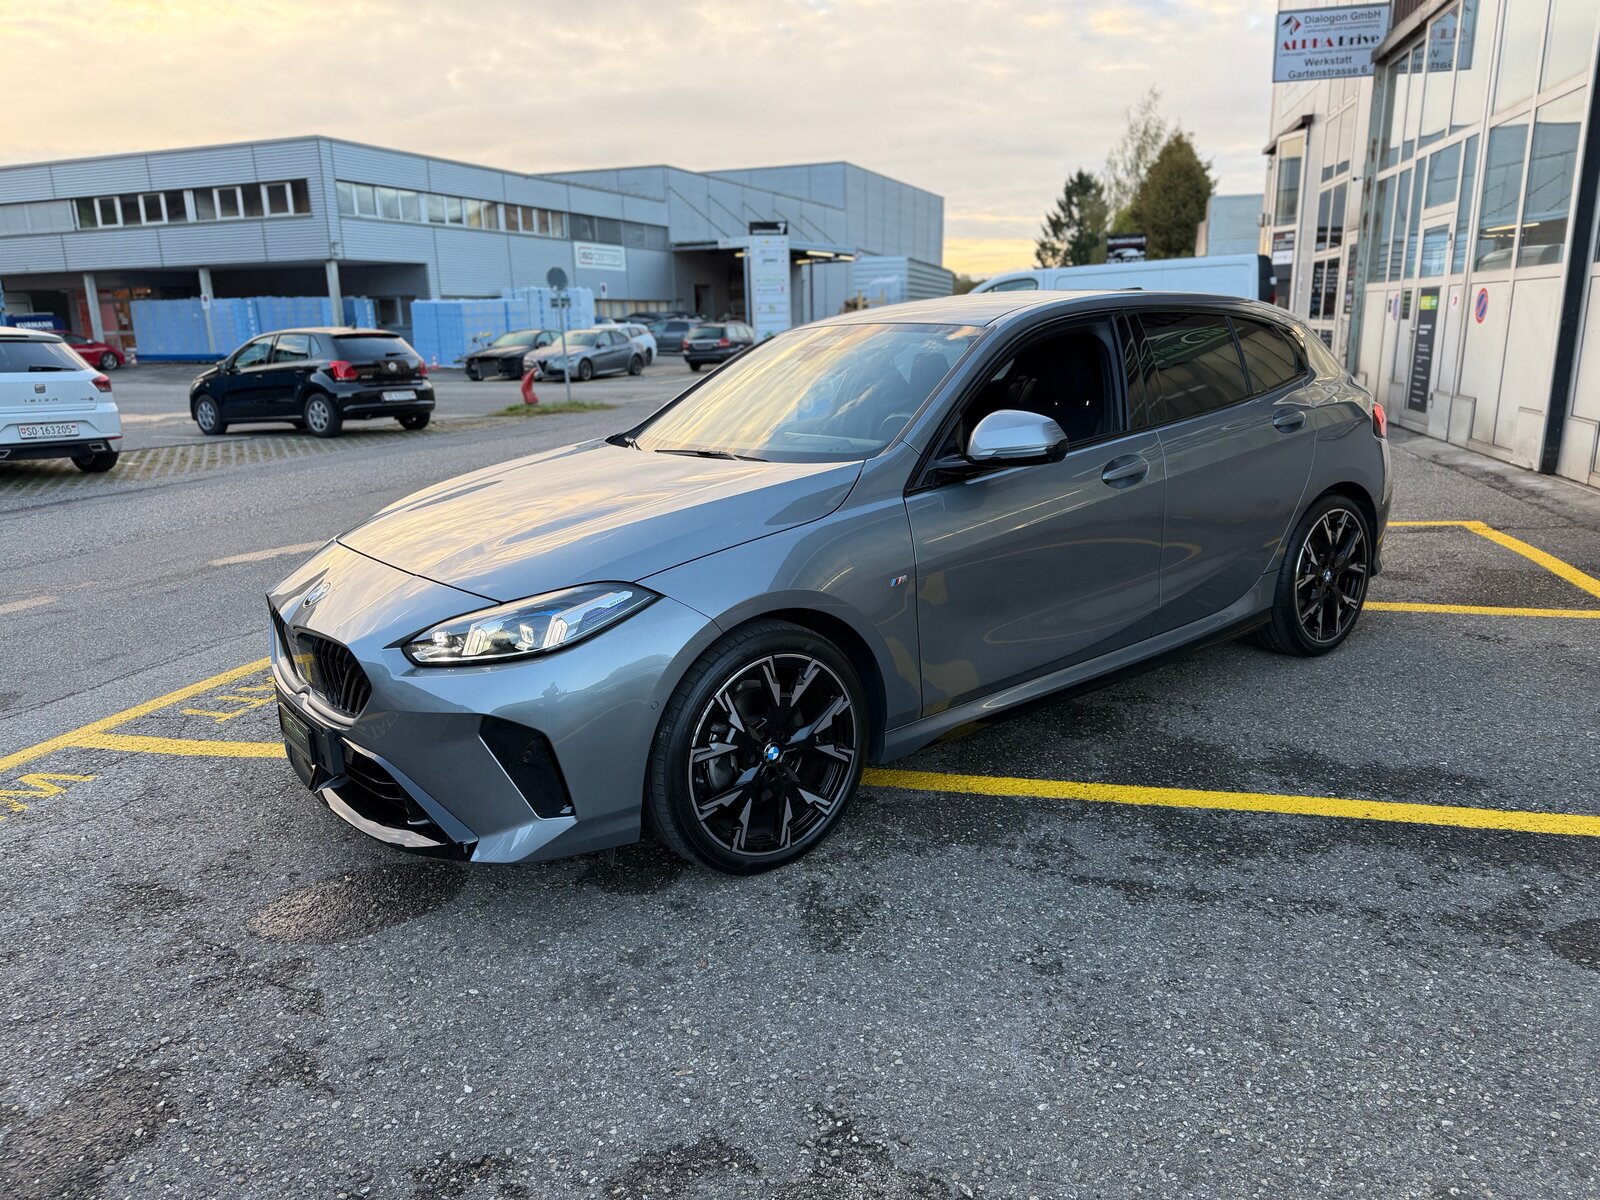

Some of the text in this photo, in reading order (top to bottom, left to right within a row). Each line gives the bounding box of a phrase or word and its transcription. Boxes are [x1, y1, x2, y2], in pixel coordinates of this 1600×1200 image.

[1304, 10, 1382, 25] Dialogon GmbH
[1280, 37, 1334, 51] ALPHA
[1338, 33, 1380, 47] Drive
[1304, 56, 1352, 67] Werkstatt
[1287, 64, 1368, 79] Gartenstrasse 6
[776, 223, 786, 234] 7
[15, 321, 54, 329] KURMANN
